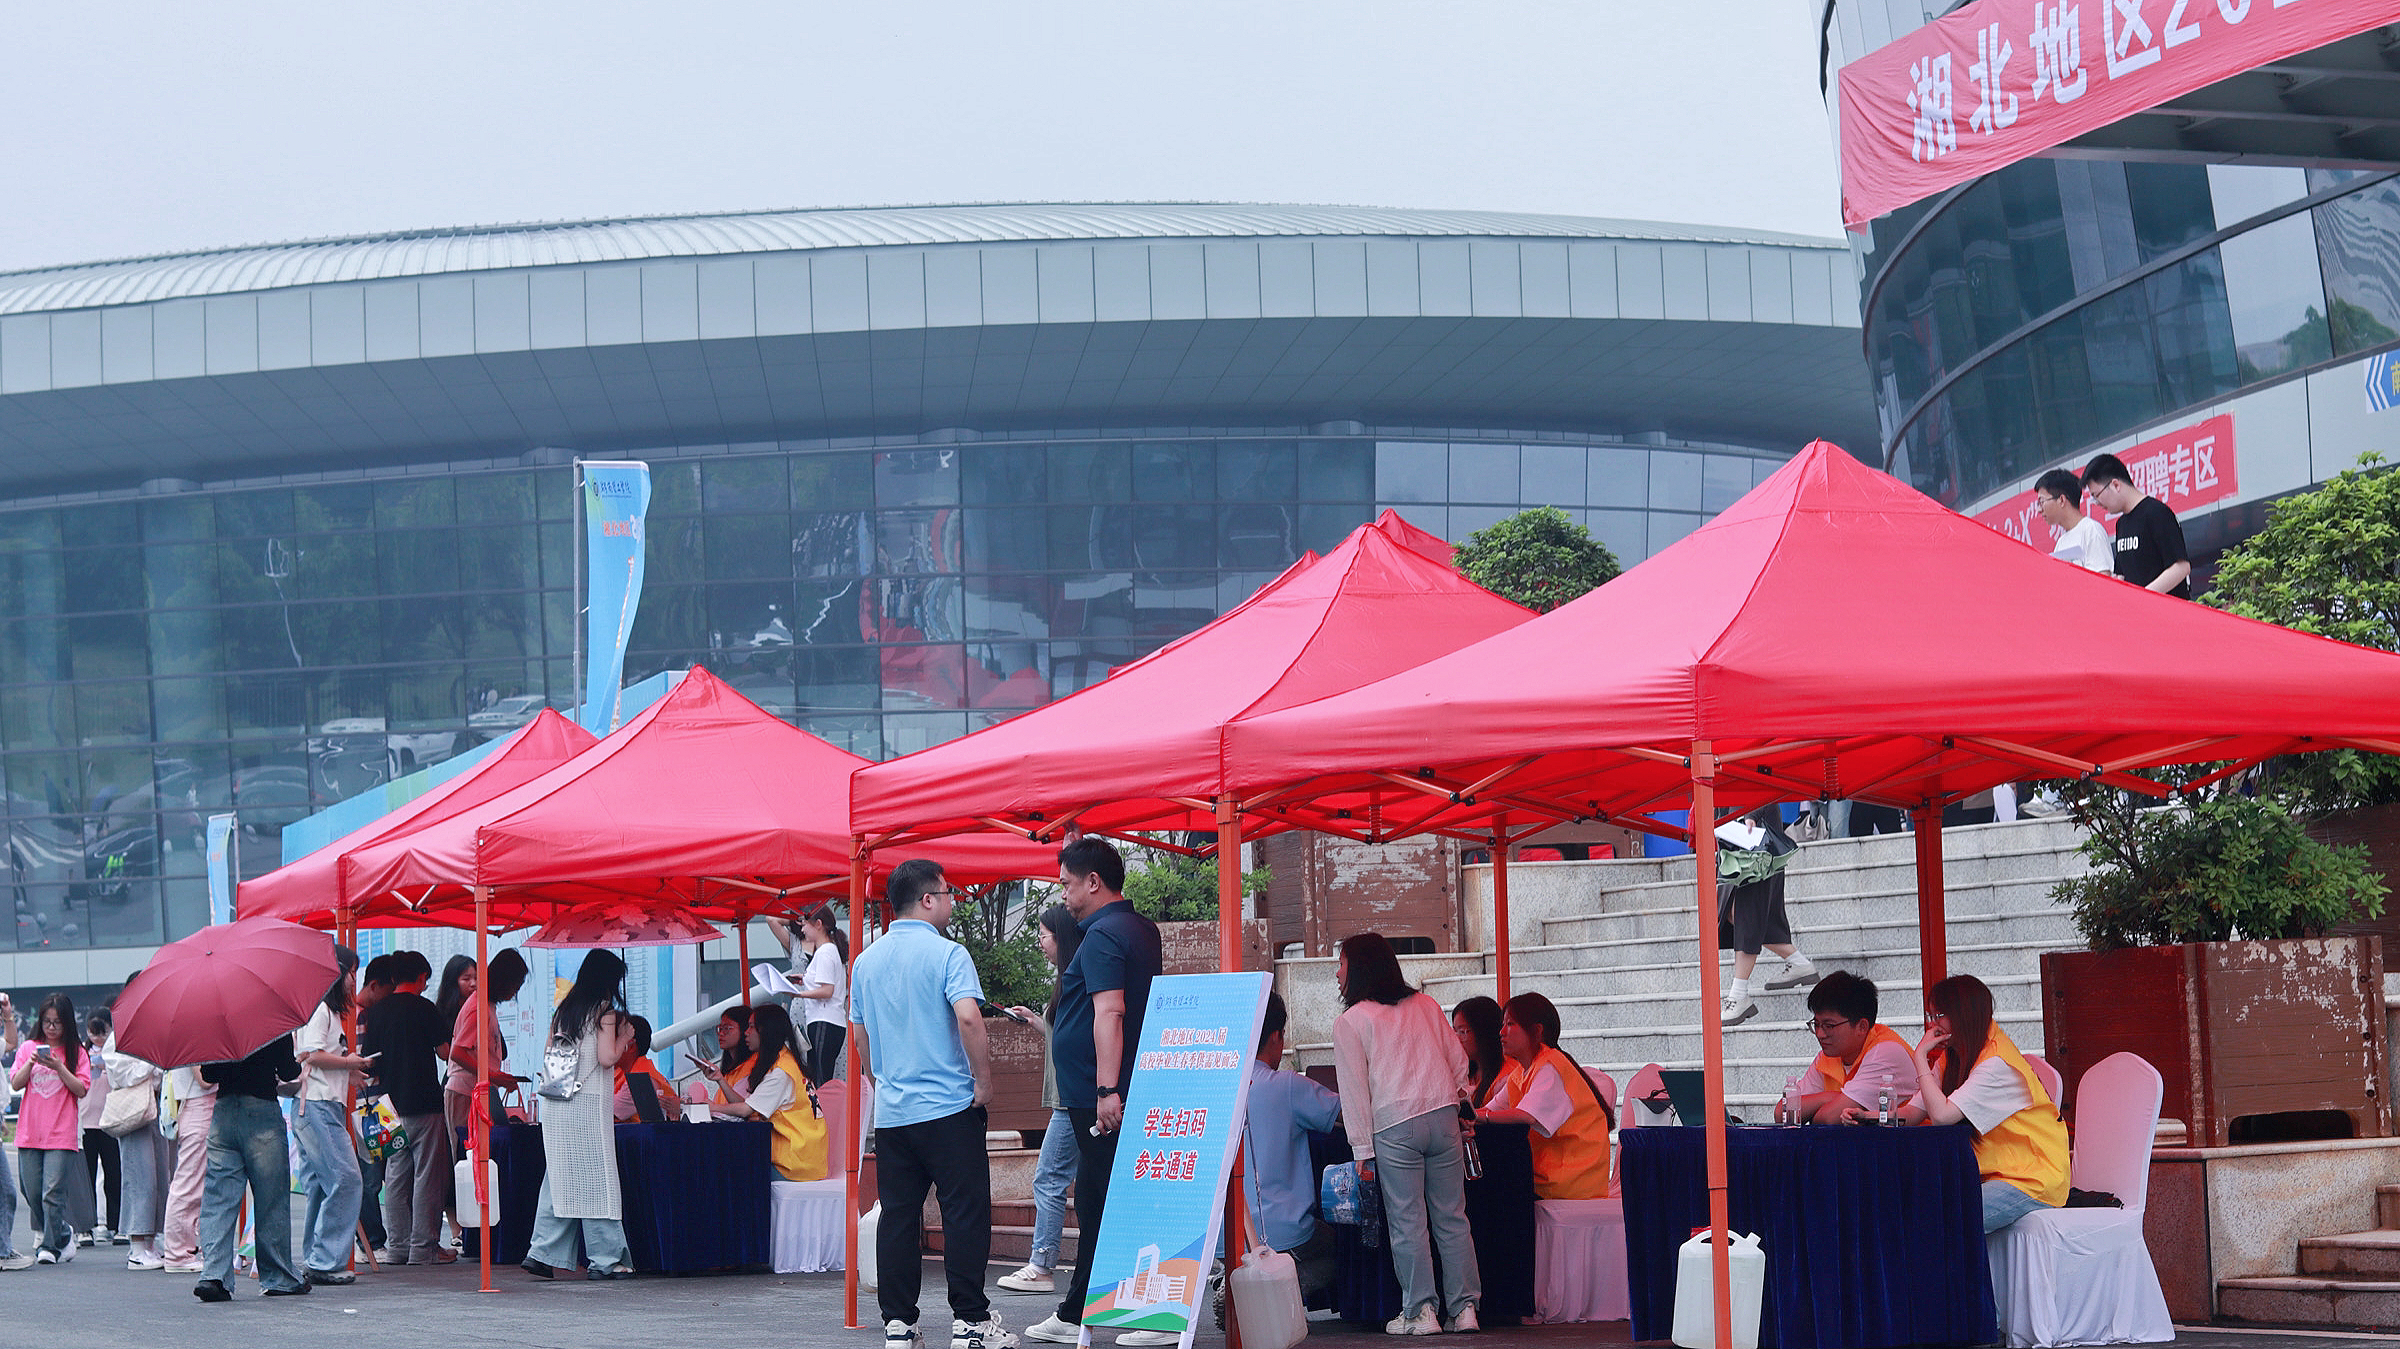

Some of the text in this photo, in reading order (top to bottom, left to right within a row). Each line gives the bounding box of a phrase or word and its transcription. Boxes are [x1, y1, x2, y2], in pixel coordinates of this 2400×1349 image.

[1906, 0, 2300, 163] 湘北地区2
[1143, 1107, 1208, 1138] 学生扫码
[1134, 1149, 1198, 1180] 参会通道
